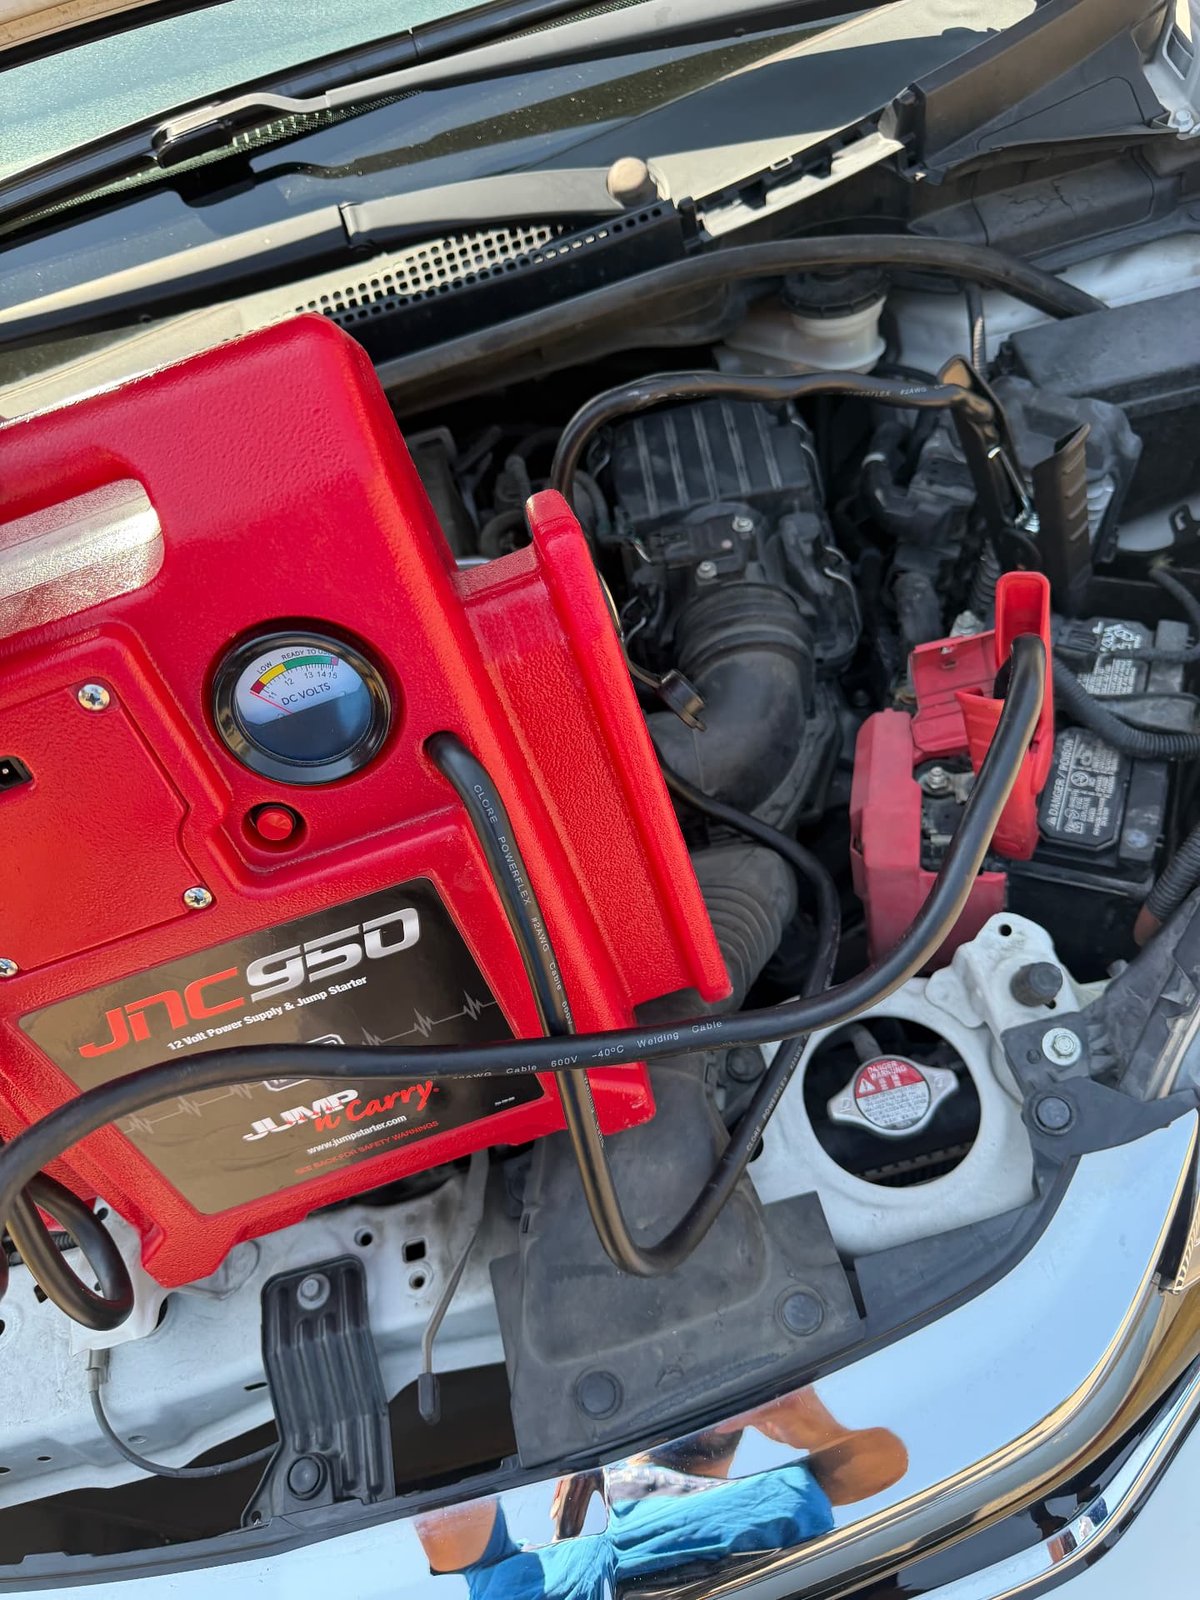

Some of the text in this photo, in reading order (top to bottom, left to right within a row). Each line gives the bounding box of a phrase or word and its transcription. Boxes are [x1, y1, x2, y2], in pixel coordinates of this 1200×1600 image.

[256, 661, 273, 675] LOW
[281, 649, 305, 660] READY
[307, 648, 317, 656] TO
[269, 670, 338, 699] 11 12 13 14 15
[281, 682, 331, 706] DC VOLTS
[473, 784, 499, 824] CLORE
[498, 836, 532, 905] POWERFLEX
[549, 961, 562, 991] Cable
[167, 975, 369, 1050] 12 Volt Power Supply & Jump Starter
[506, 1065, 538, 1075] Cable
[550, 1055, 578, 1068] 600V
[636, 1031, 680, 1049] Welding
[691, 1020, 723, 1034] Cable
[242, 1088, 360, 1142] JUMP
[306, 1114, 408, 1156] www.jumpstarter.com
[357, 1136, 392, 1154] SAFETY
[391, 1119, 440, 1141] WARNINGS
